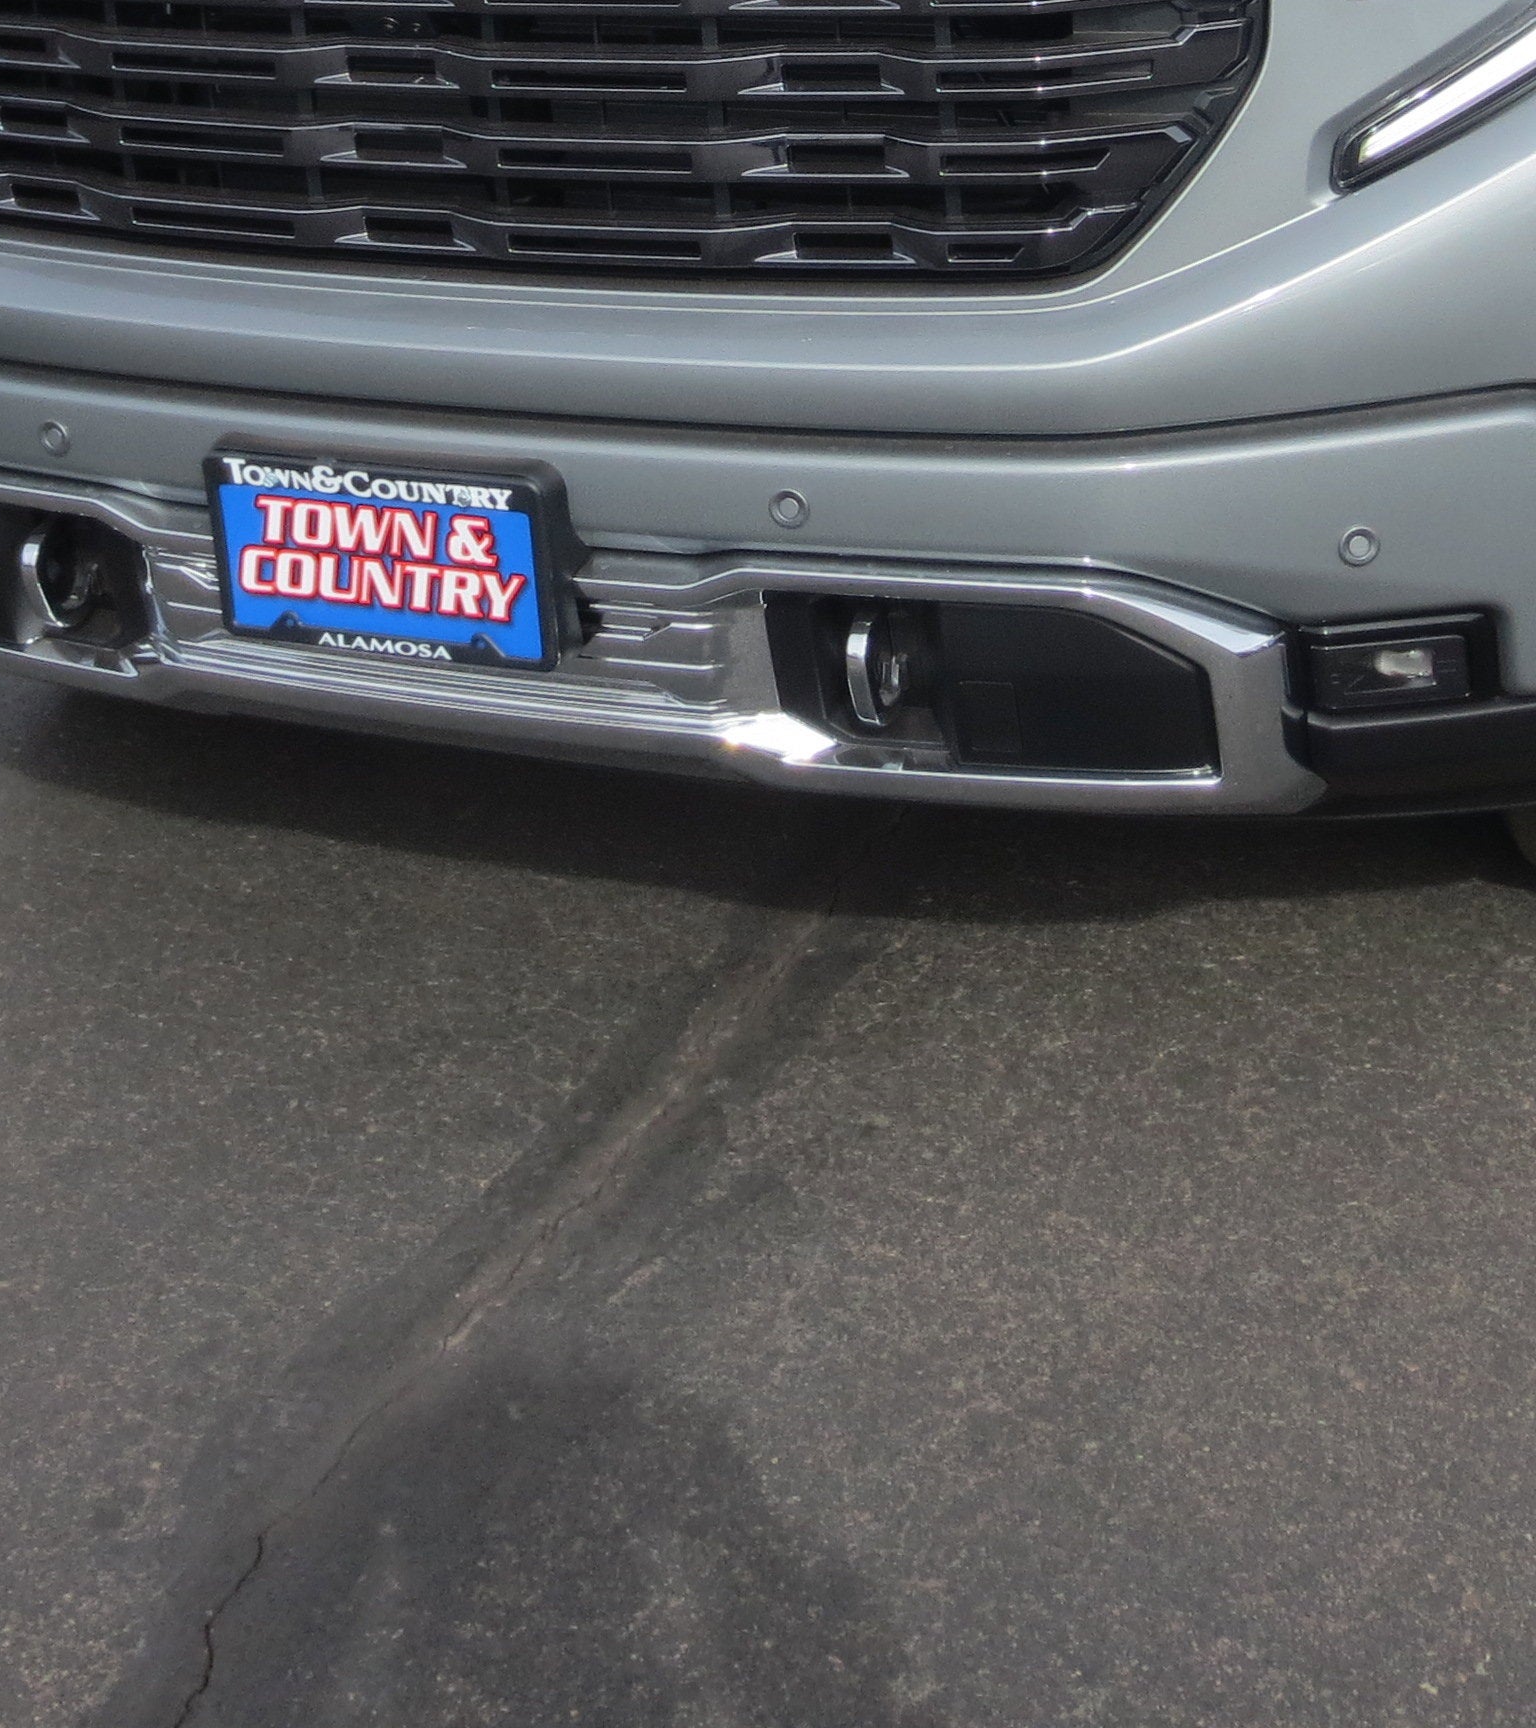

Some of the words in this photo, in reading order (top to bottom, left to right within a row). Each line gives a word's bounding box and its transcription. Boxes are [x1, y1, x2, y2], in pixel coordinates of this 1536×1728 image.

[255, 495, 438, 561] TOWN
[445, 514, 498, 567] &
[239, 544, 526, 624] COUNTRY
[318, 631, 452, 661] ALAMOSA
